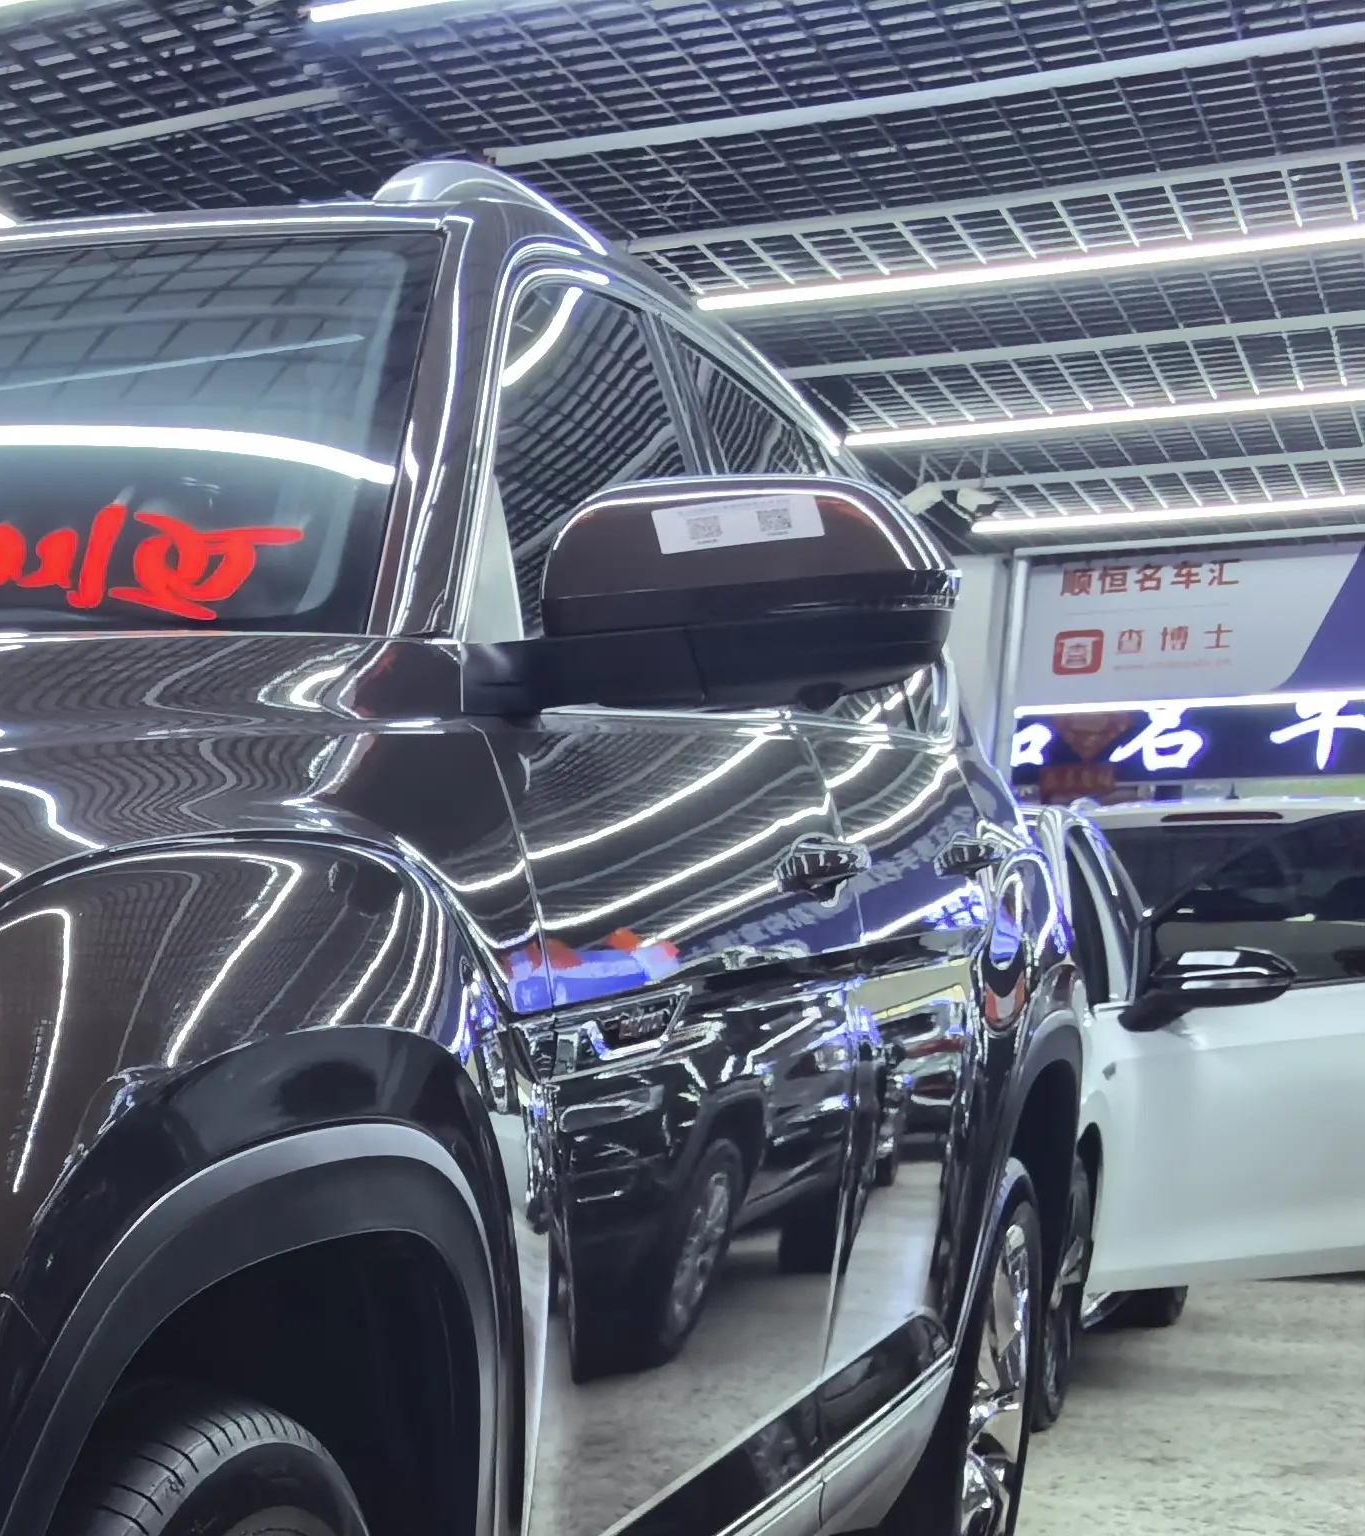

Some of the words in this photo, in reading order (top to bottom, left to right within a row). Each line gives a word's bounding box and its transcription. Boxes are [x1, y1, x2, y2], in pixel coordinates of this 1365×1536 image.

[1059, 557, 1242, 597] 顺恒名车汇
